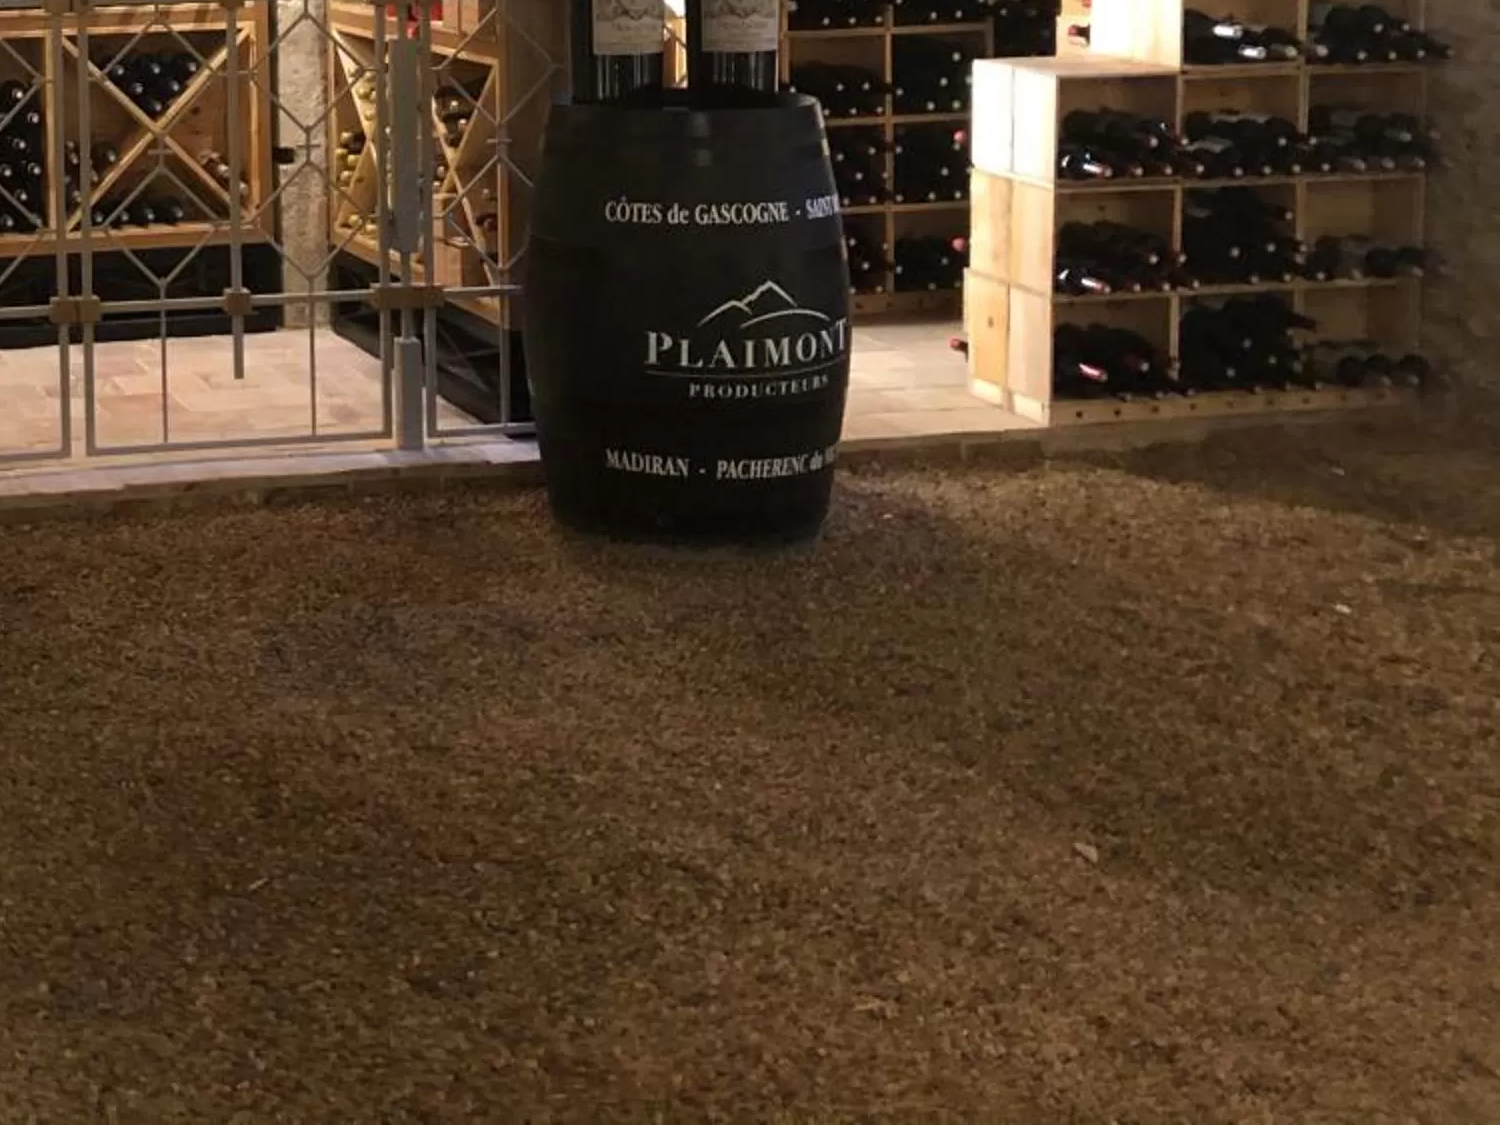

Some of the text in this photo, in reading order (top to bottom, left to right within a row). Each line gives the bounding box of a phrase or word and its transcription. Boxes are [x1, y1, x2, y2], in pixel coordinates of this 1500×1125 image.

[605, 195, 662, 223] CÔTES
[667, 202, 689, 224] de
[694, 201, 789, 225] GASCOGNE
[644, 317, 847, 369] PLAIMONT
[689, 375, 829, 398] PRODUCTEURS
[605, 448, 690, 478] MADIRAN
[716, 453, 809, 480] PACHERENC
